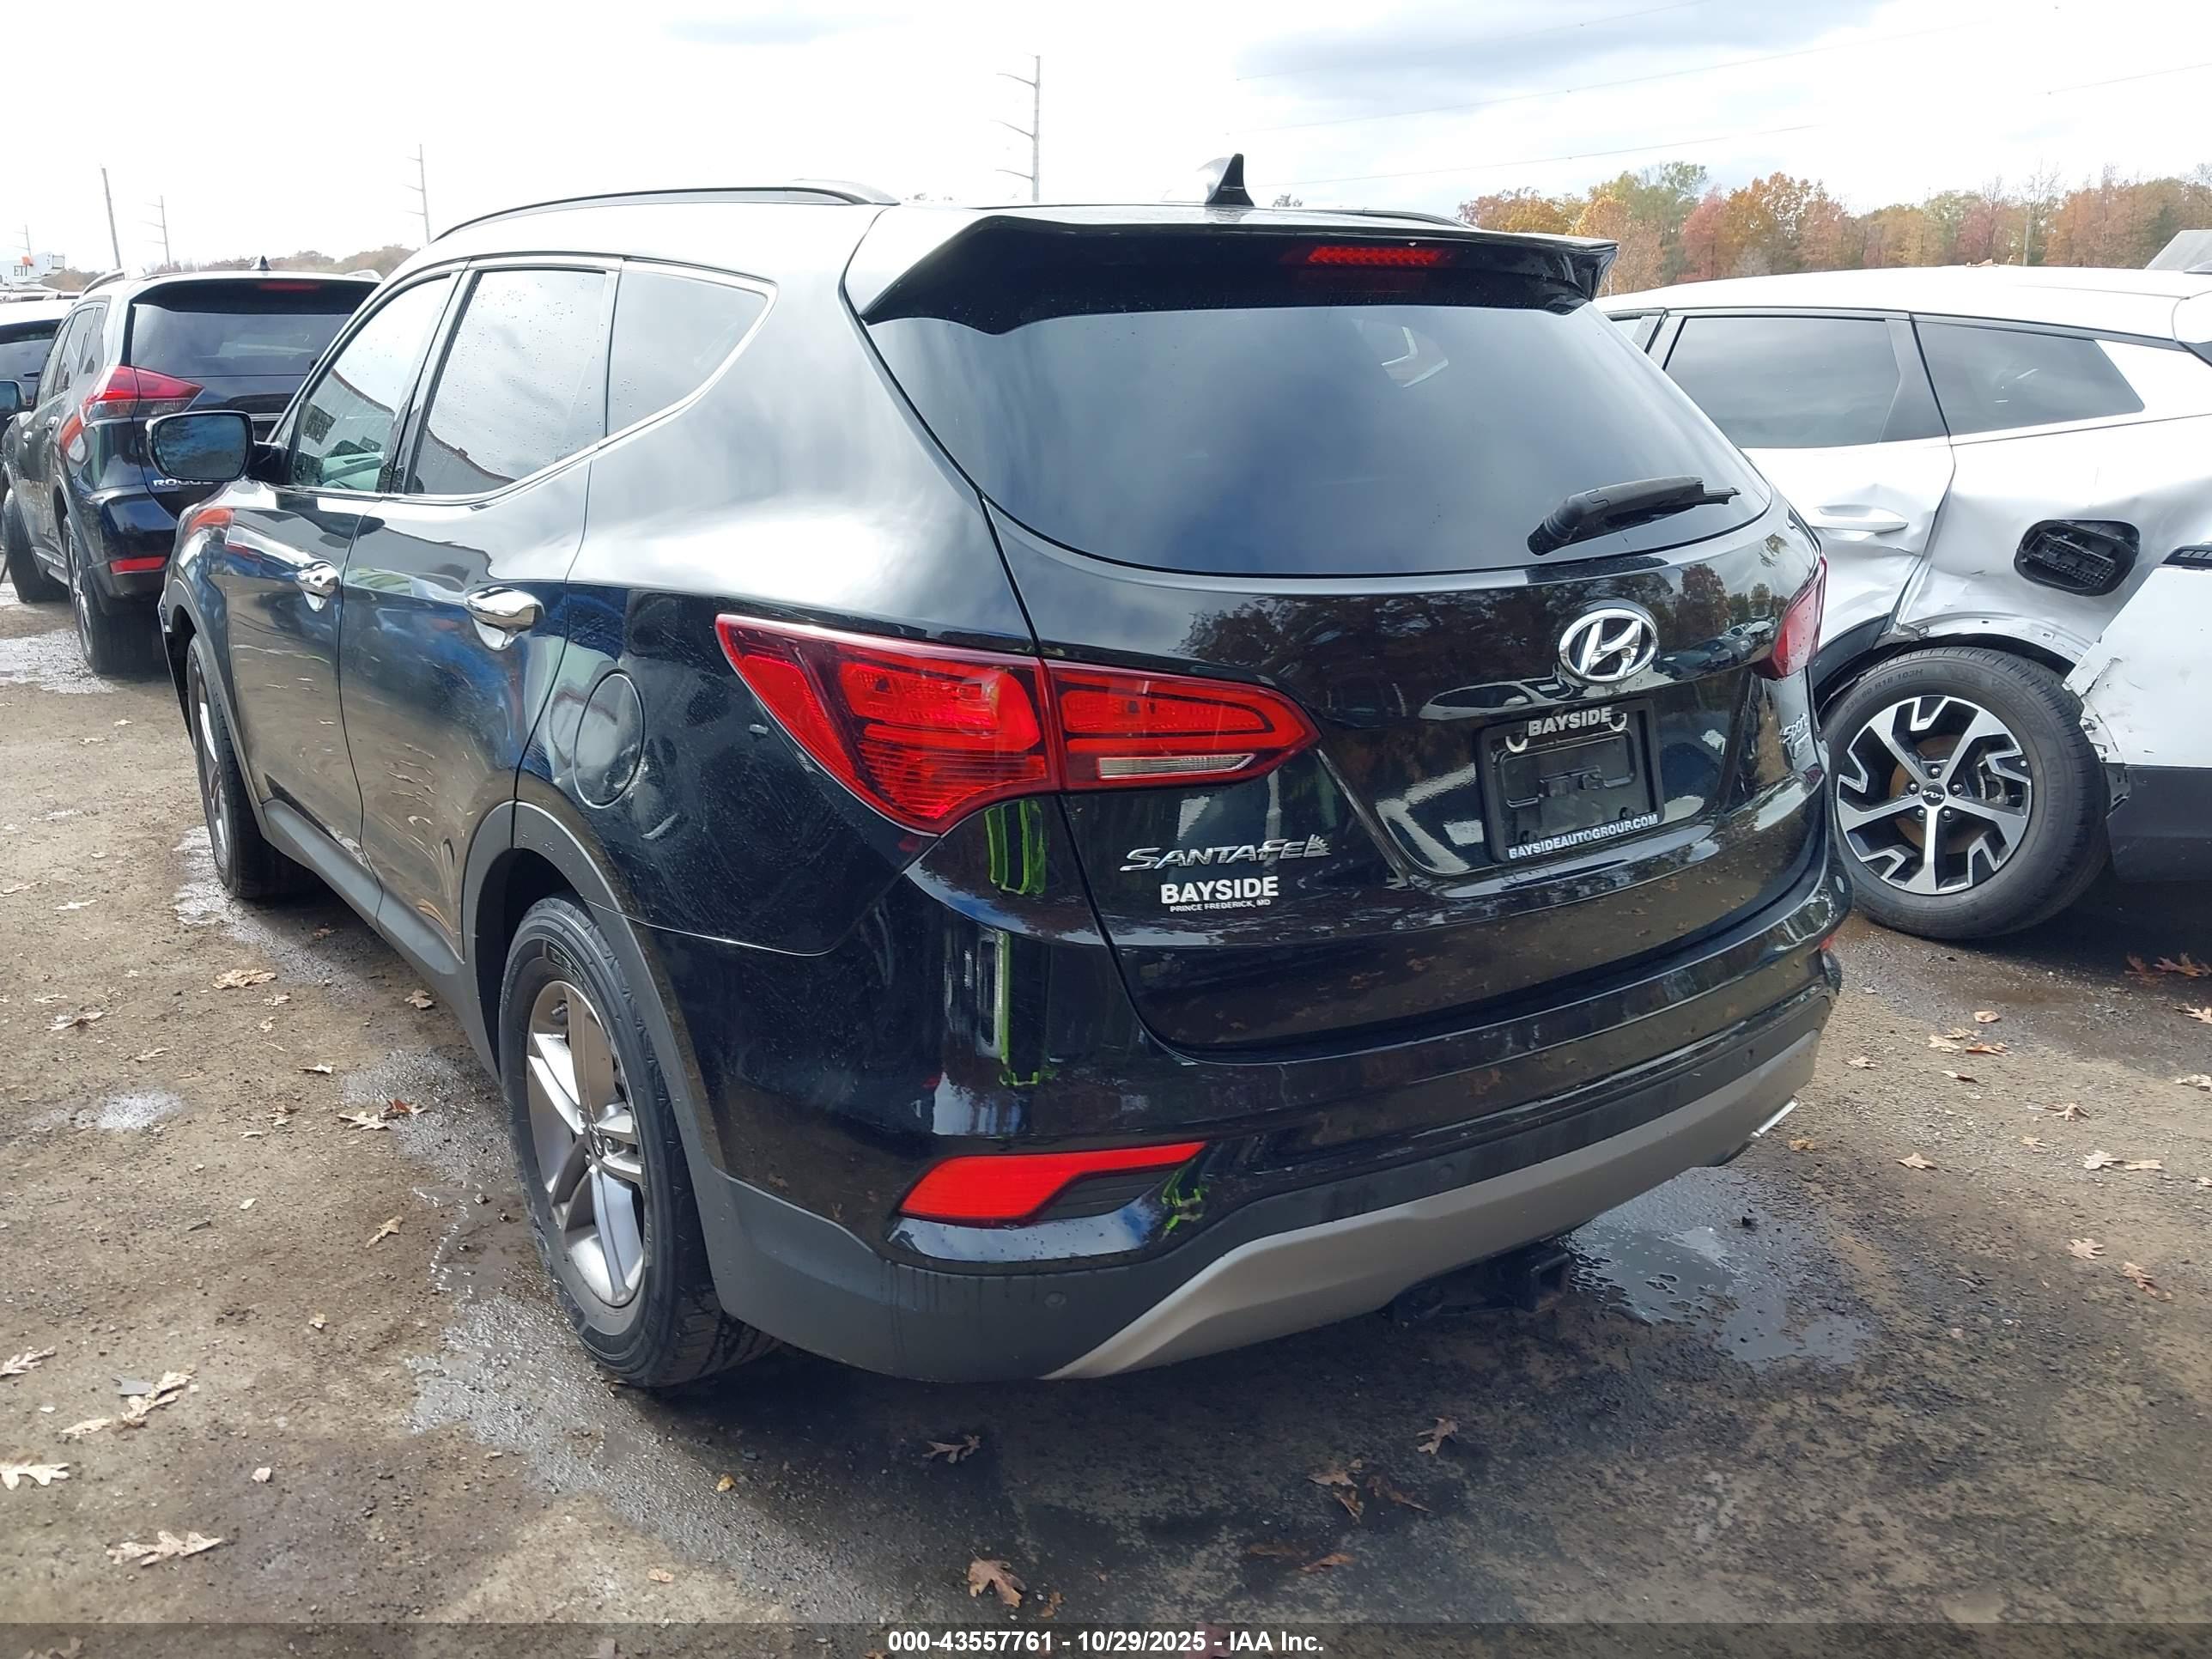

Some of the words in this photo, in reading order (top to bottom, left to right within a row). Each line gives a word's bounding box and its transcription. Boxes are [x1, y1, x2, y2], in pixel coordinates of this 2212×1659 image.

[1528, 707, 1613, 737] BAYSIDE
[1160, 876, 1279, 903] BAYSIDE
[1204, 901, 1255, 910] FREDERICK,
